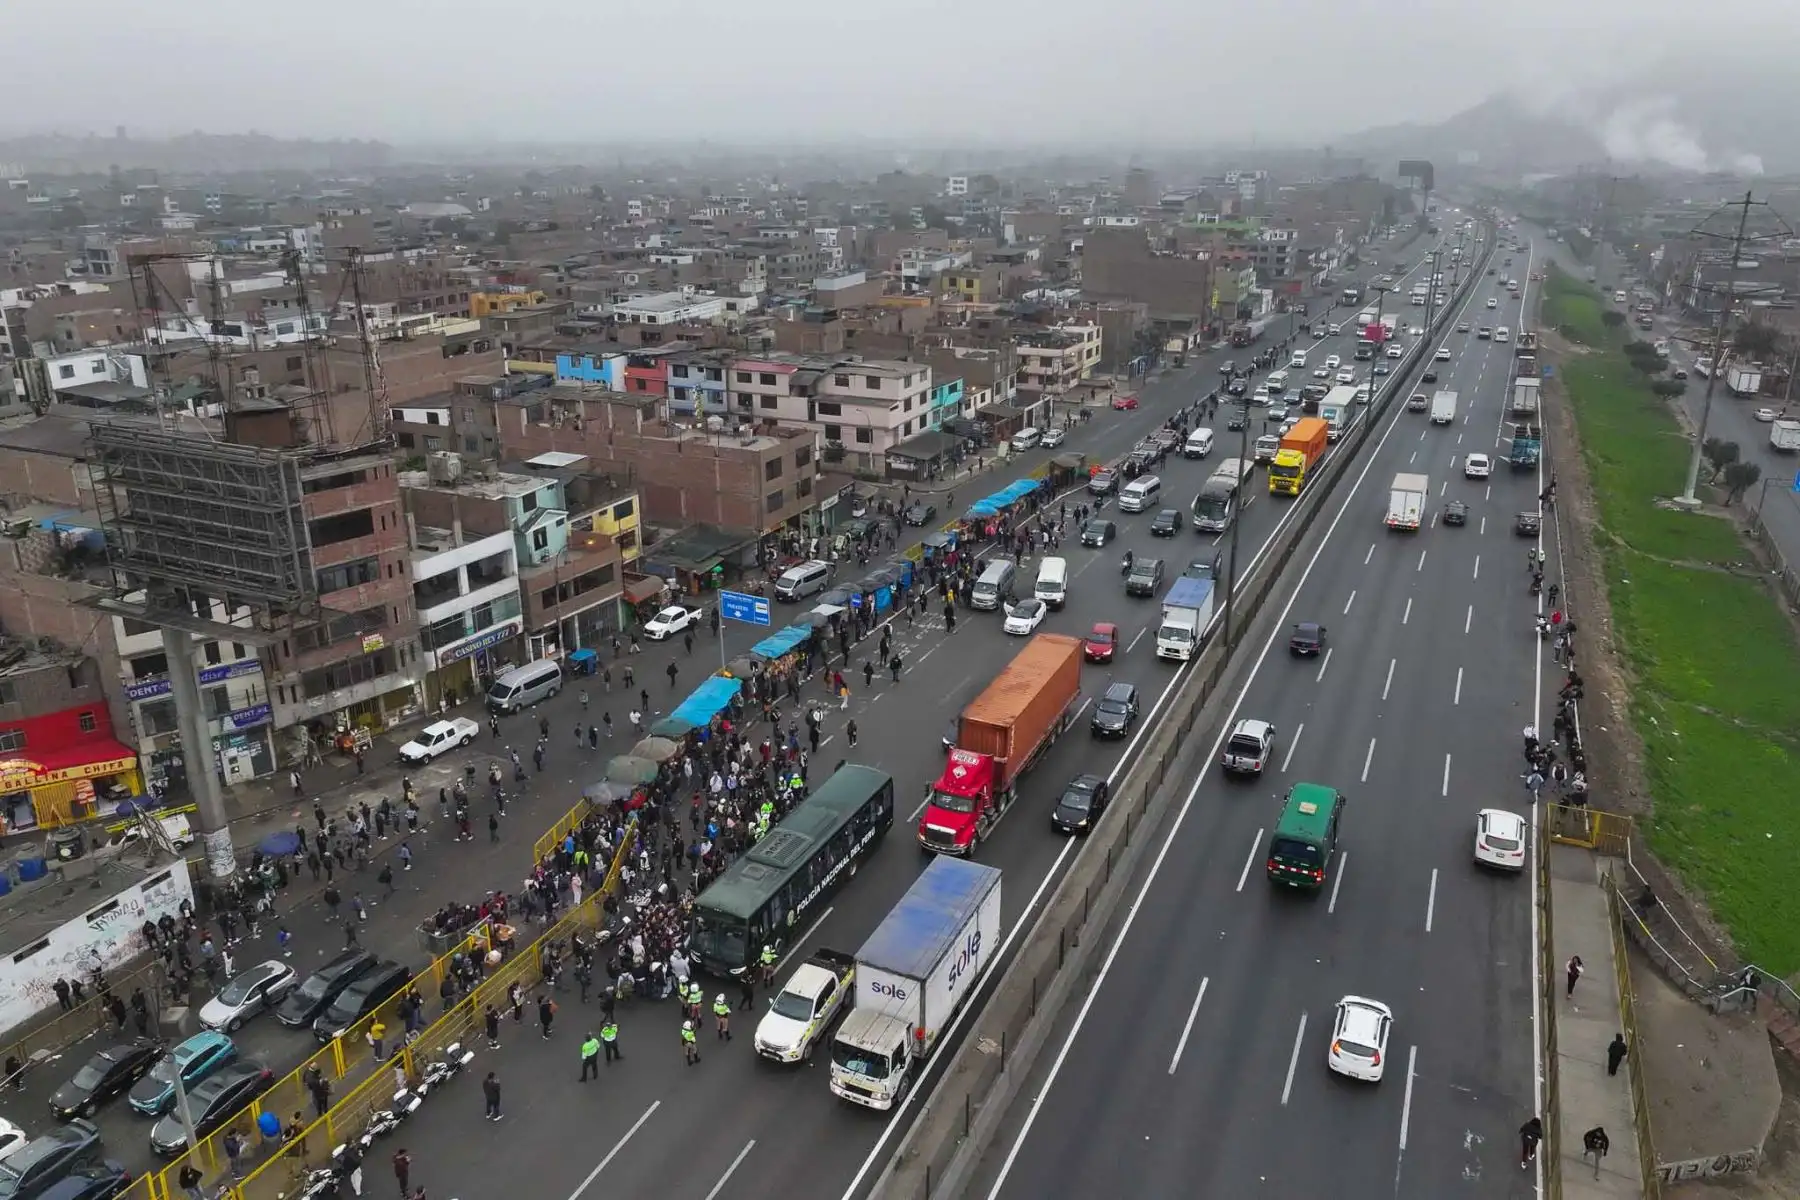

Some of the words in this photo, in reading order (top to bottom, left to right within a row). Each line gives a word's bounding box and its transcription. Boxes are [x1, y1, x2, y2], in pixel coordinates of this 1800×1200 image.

[455, 641, 482, 657] CASINO
[482, 635, 496, 646] REY
[5, 770, 69, 789] GALLINA
[84, 760, 125, 775] CHIFA
[821, 854, 850, 889] NACIONAL
[850, 842, 861, 859] DEL
[948, 930, 982, 992] sole
[871, 981, 906, 1000] sole
